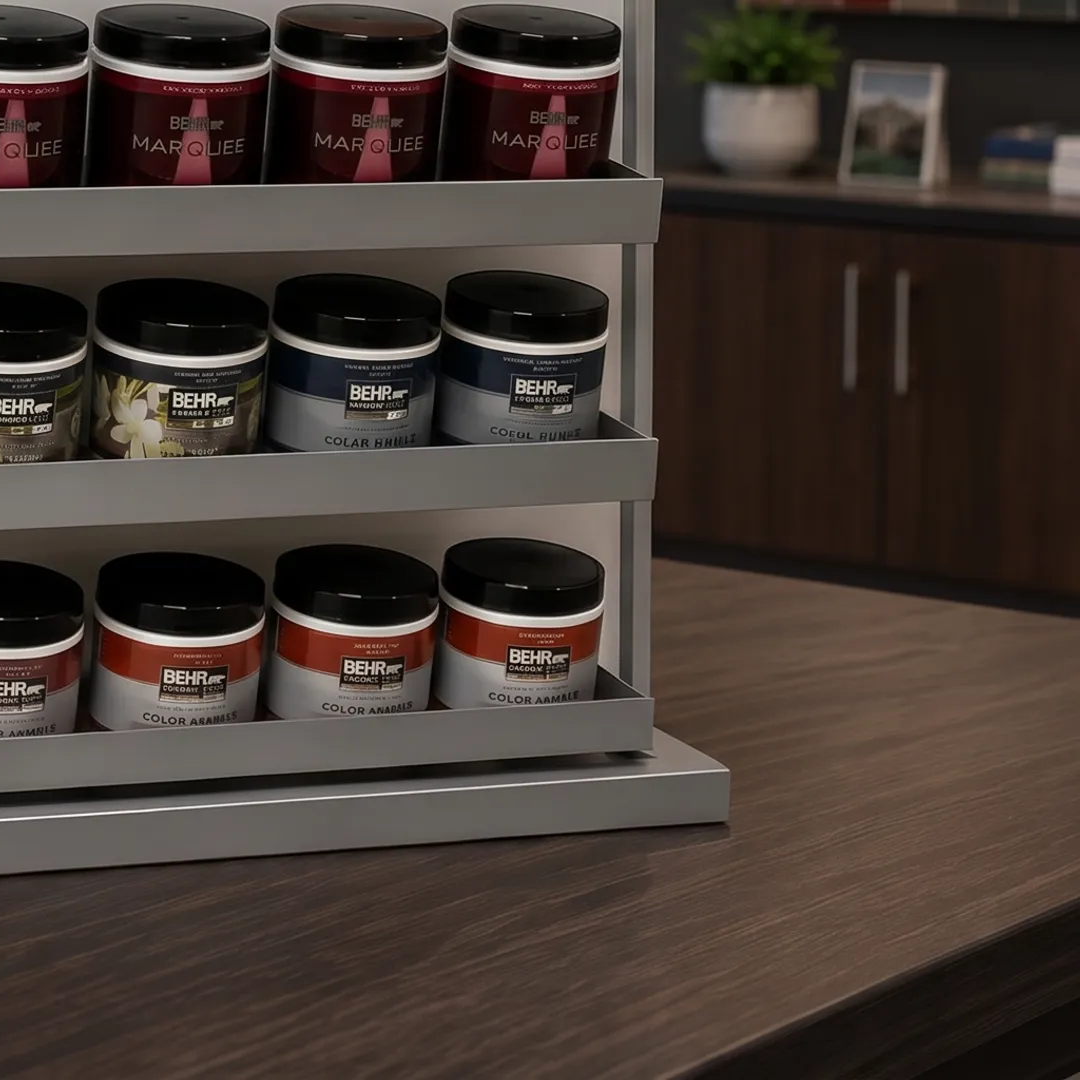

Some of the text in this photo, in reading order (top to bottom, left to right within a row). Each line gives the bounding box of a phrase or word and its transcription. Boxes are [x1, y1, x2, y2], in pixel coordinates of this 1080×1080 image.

[132, 134, 245, 157] MARQUEE
[314, 132, 424, 154] MARQUEE
[491, 130, 598, 151] MARQUEE
[350, 384, 392, 401] BEHR
[515, 378, 558, 395] BEHR
[172, 391, 218, 409] BEHR
[509, 648, 552, 664] BEHR
[343, 659, 386, 675] BEHR
[163, 669, 209, 685] BEHR
[488, 692, 532, 705] COLOR
[322, 702, 365, 715] COLOR
[142, 712, 186, 725] COLOR
